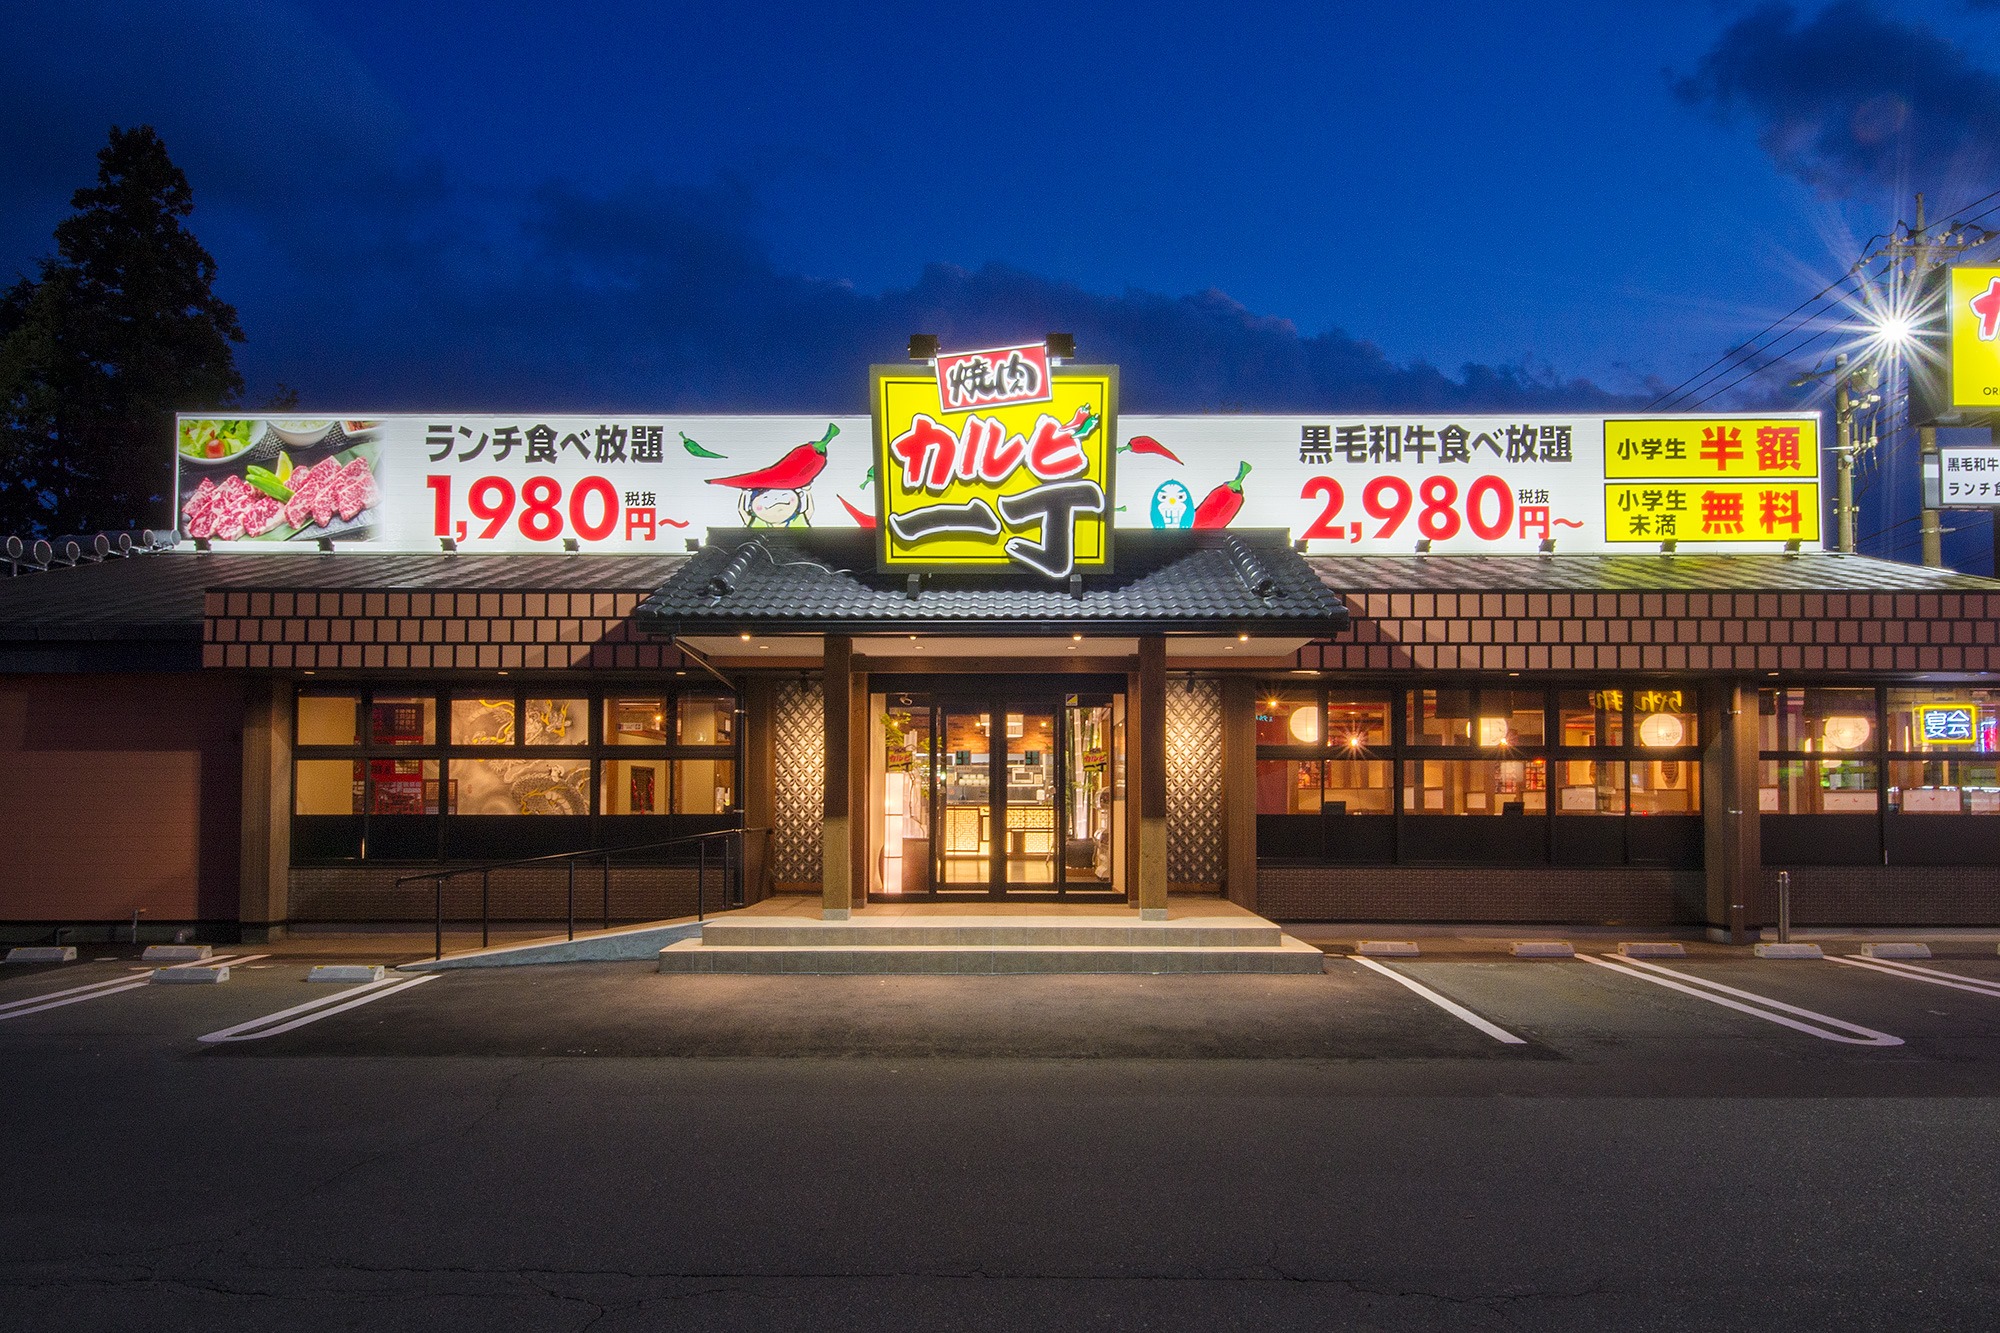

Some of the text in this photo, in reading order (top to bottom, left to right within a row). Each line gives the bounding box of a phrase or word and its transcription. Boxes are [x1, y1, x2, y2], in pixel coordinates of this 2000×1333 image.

[949, 354, 1040, 406] 焼肉
[1982, 386, 2000, 396] OR
[425, 424, 664, 464] ランチ食べ放題
[891, 412, 1090, 490] カルビ
[1299, 424, 1573, 464] 黒毛和牛食べ放題
[1616, 426, 1801, 471] 小学生 半額
[1947, 457, 1999, 472] 黒毛和牛
[625, 491, 656, 507] 税抜
[1518, 488, 1550, 505] 税抜
[1617, 489, 1802, 534] 小学生 無料
[889, 481, 1104, 577] 一丁
[1629, 514, 1677, 536] 未満
[1925, 709, 1971, 739] 宴会
